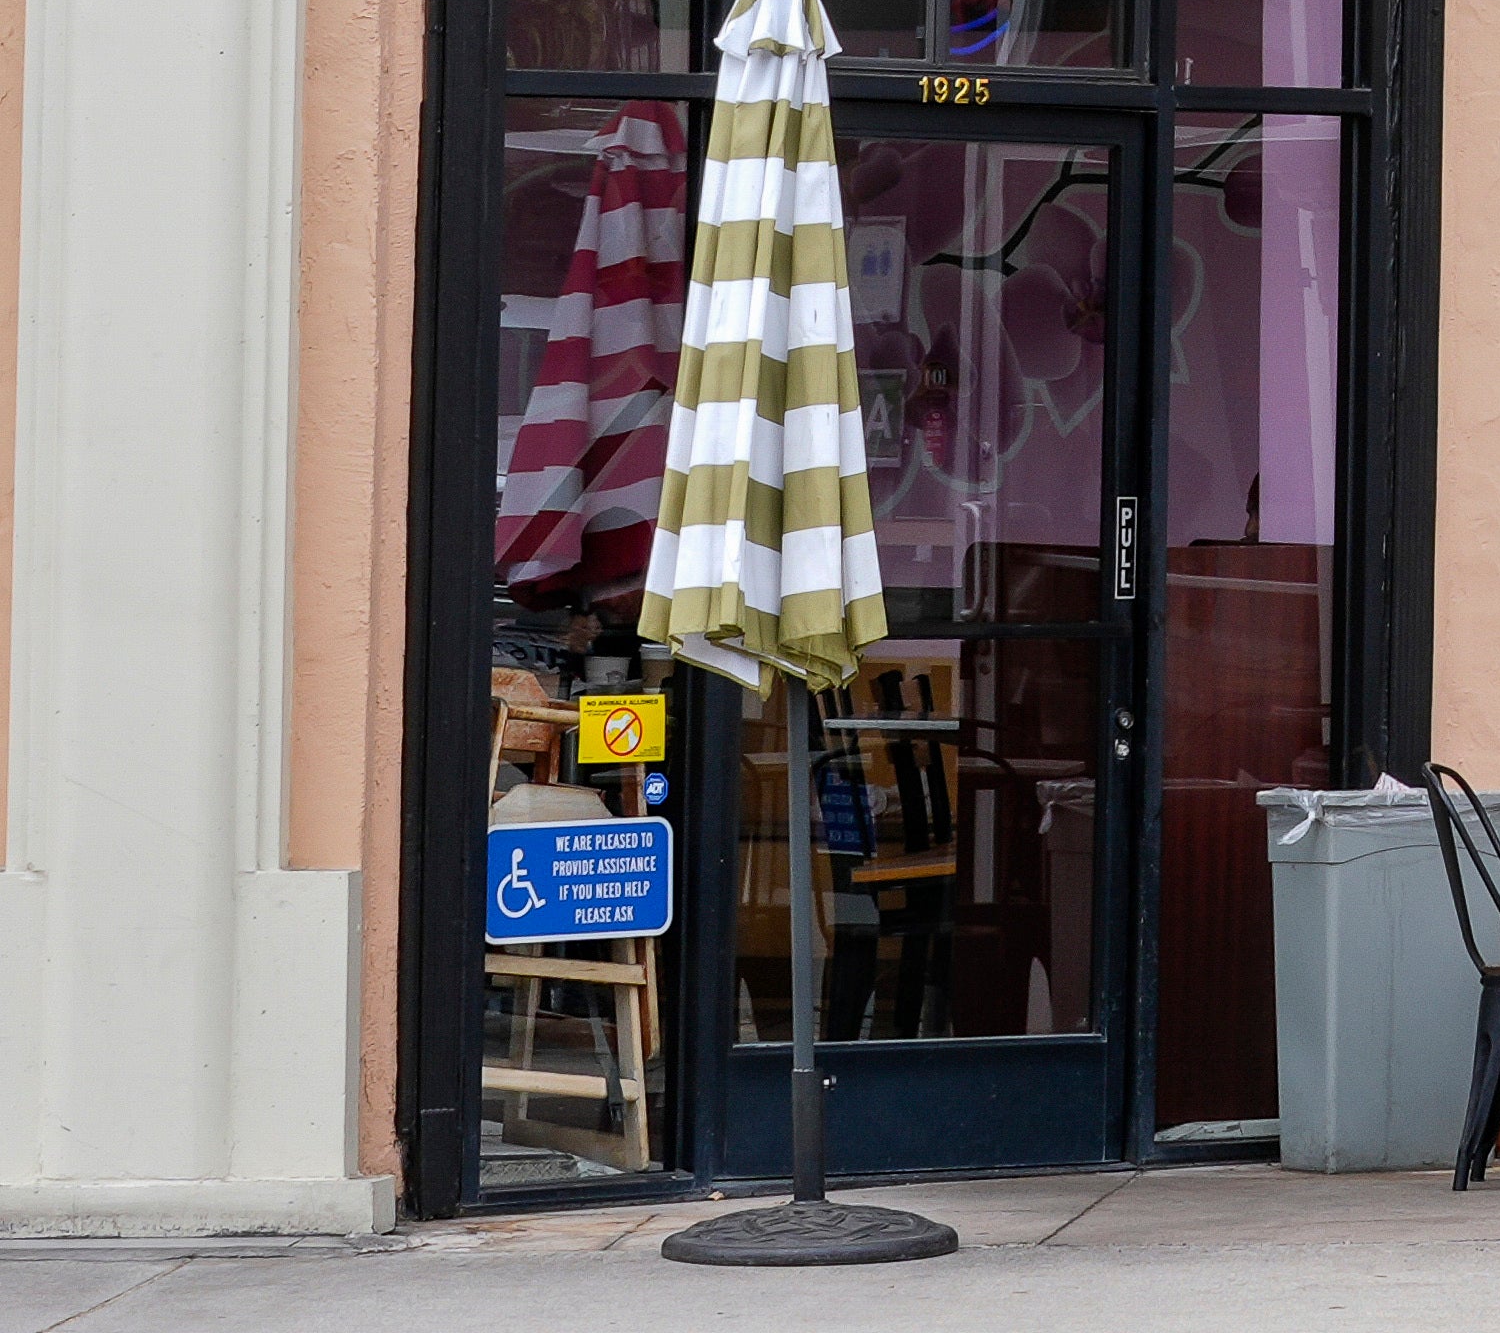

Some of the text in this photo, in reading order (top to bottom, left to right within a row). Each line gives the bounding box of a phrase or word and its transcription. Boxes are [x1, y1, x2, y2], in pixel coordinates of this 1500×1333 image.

[919, 76, 990, 105] 1925
[1121, 507, 1133, 588] PULL
[556, 832, 653, 851] WE ARE PLEASED TO
[553, 856, 656, 876] PROVIDE ASSISTANCE
[559, 881, 650, 900] IF YOU NEED HELP
[575, 906, 634, 924] PLEASE ASK
